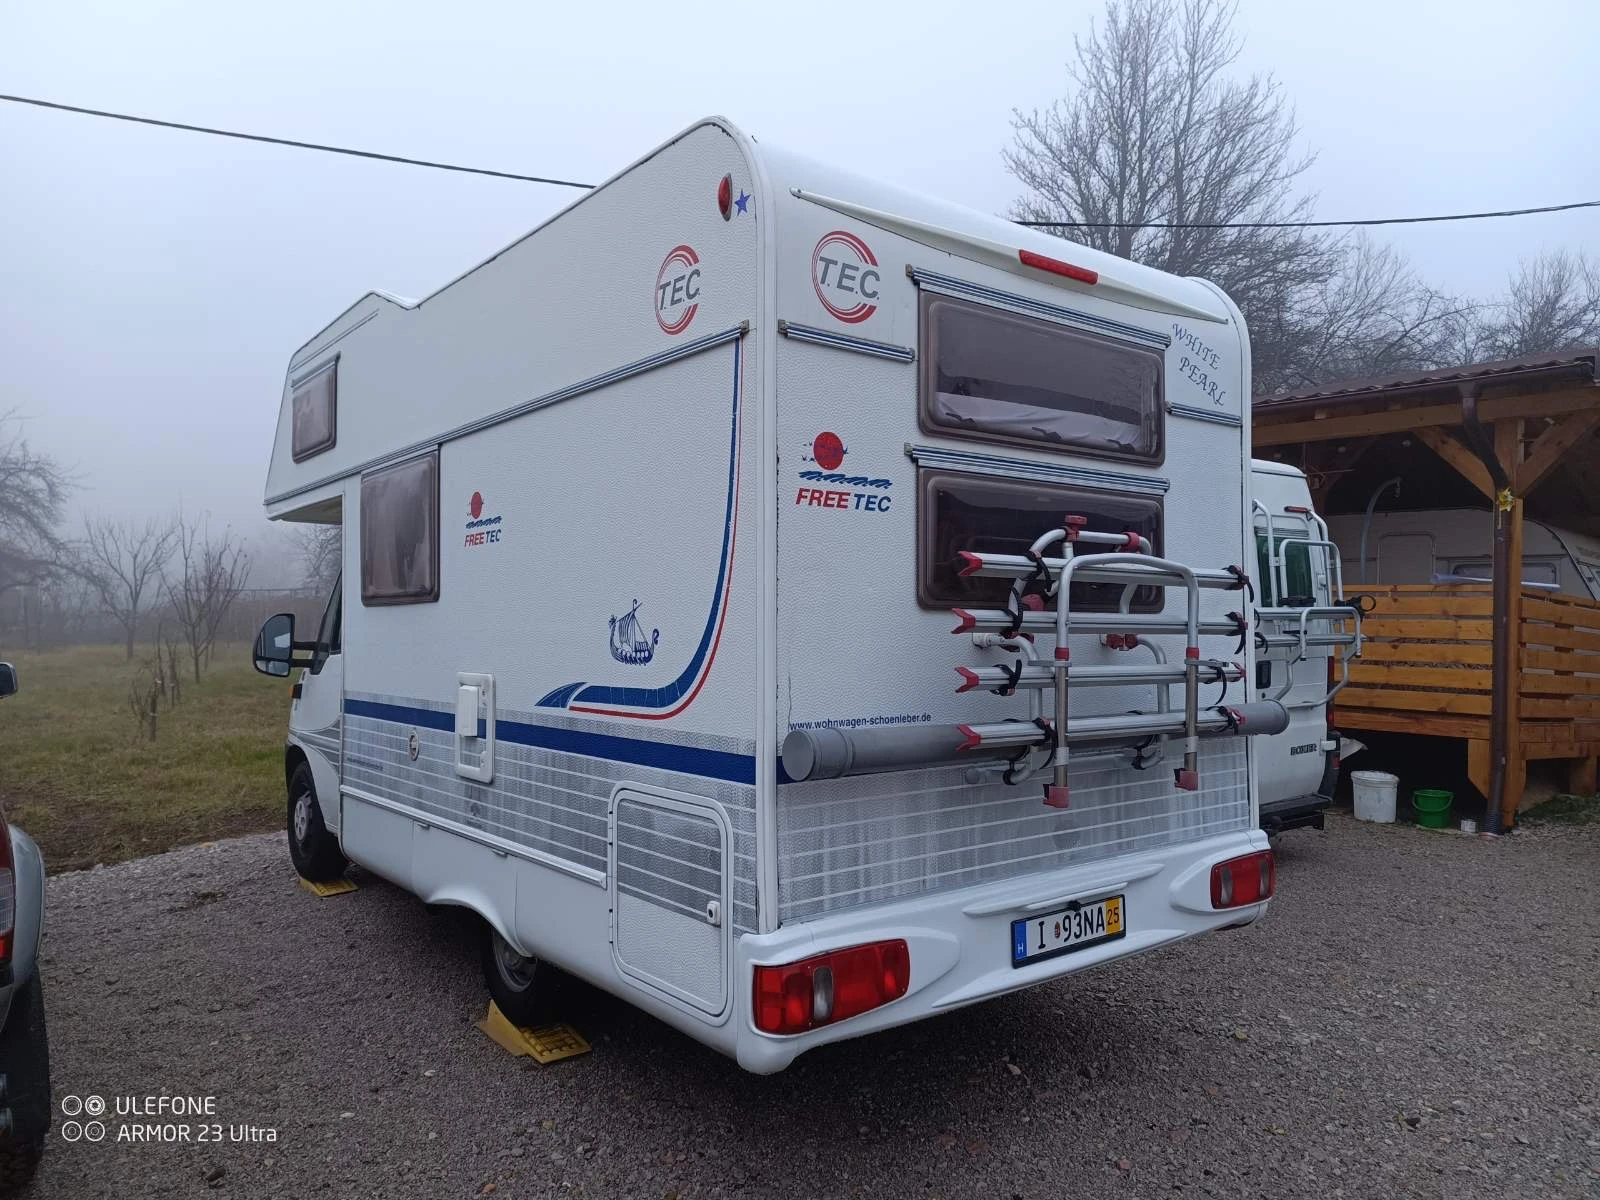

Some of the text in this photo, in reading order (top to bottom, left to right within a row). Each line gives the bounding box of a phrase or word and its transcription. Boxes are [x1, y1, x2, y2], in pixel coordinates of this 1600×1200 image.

[1172, 323, 1221, 371] WHITE
[1179, 356, 1226, 407] PEARL
[789, 712, 932, 731] www.wohnwagen-schoenleber.de
